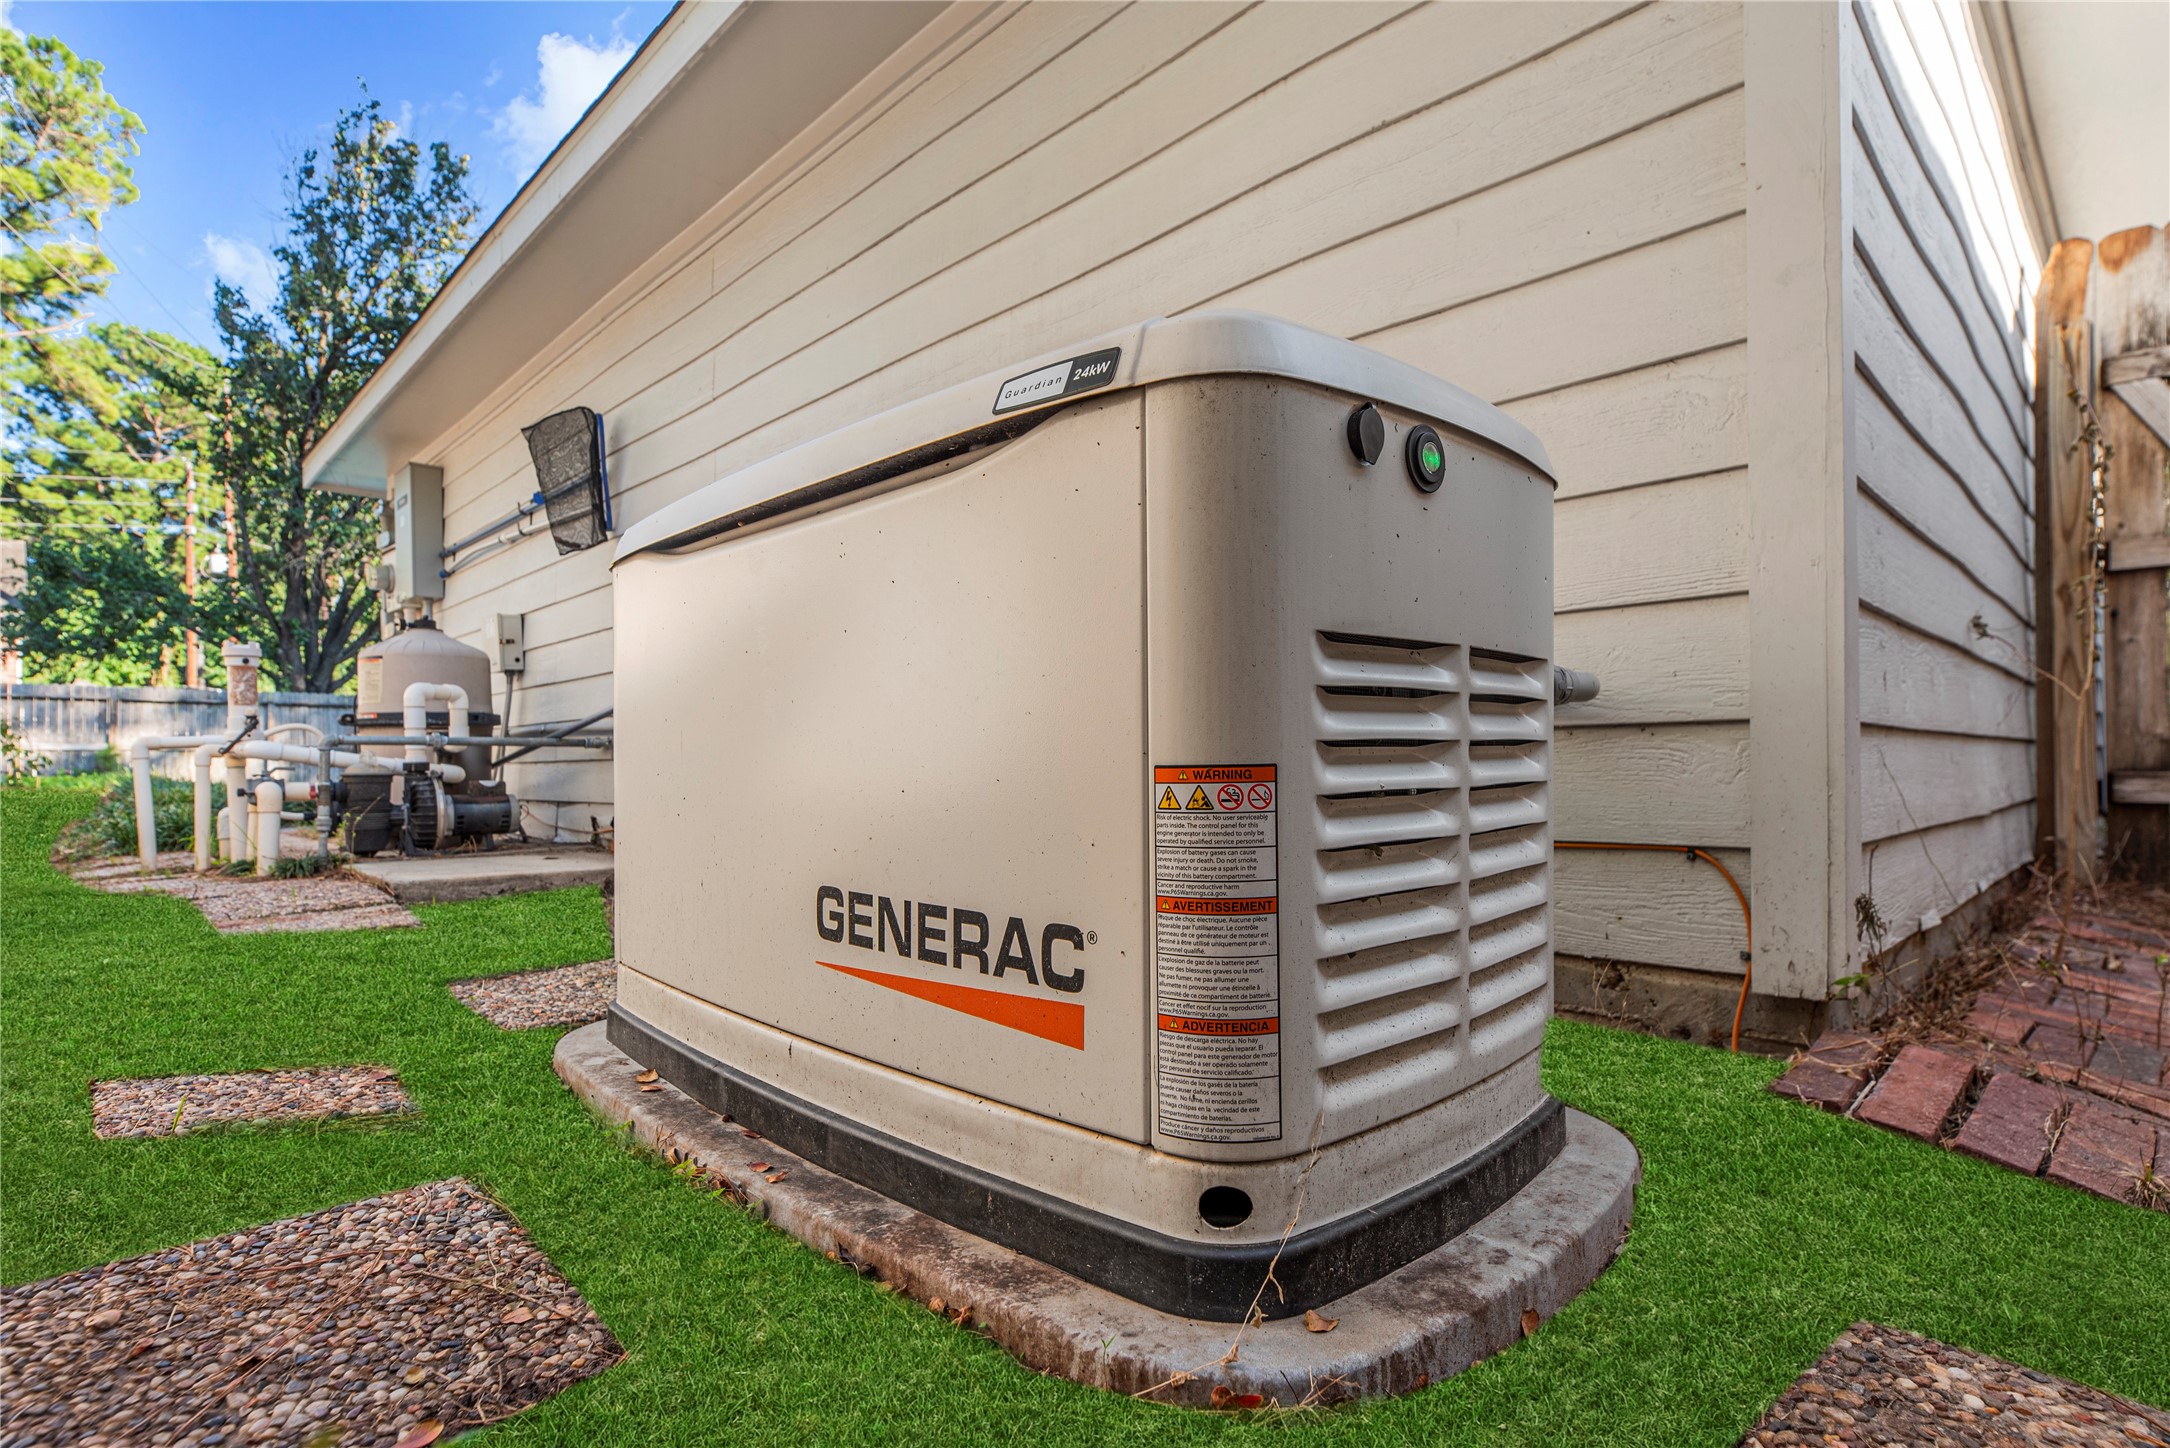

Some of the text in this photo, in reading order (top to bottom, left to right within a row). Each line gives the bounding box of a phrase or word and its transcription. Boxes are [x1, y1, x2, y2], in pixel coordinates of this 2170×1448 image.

[1004, 360, 1112, 399] Guardian 24kW
[1193, 769, 1252, 780] WARNING
[1172, 900, 1274, 912] AVERTISSEMENT
[1182, 1020, 1270, 1032] ADVERTENCIA
